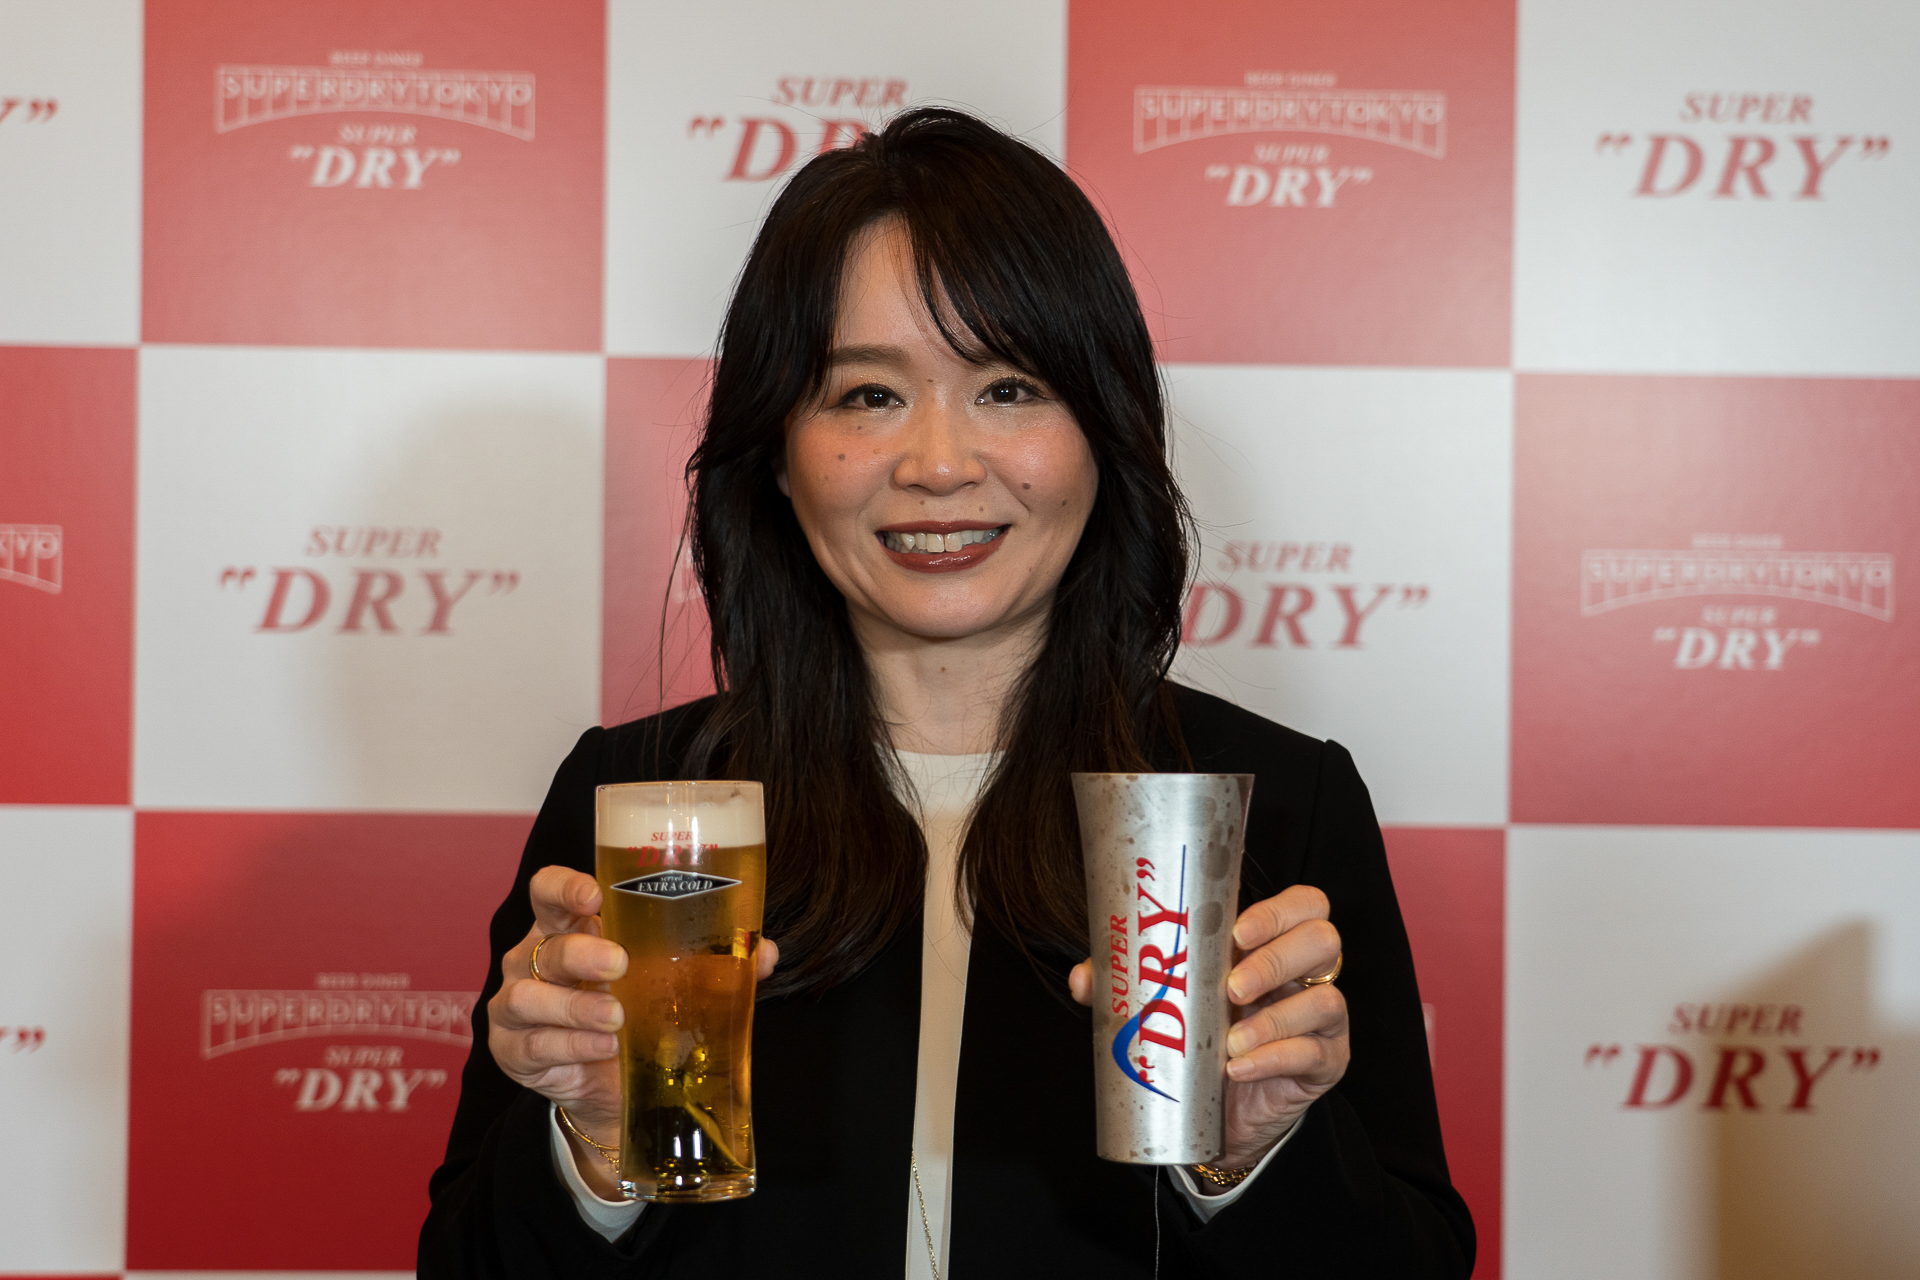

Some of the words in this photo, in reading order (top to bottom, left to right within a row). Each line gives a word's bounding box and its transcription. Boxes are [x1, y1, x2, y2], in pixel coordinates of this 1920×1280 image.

[772, 76, 908, 108] SUPER
[1680, 91, 1814, 123] SUPER
[306, 526, 442, 559] SUPER
[1218, 540, 1352, 573] SUPER
[1180, 582, 1430, 650] DRY”
[651, 831, 694, 842] SUPER
[637, 881, 677, 892] EXTRA
[679, 880, 713, 891] COLD
[1110, 915, 1128, 1018] SUPER
[211, 999, 469, 1025] SUPERDRYTOK
[1669, 1003, 1804, 1036] SUPER
